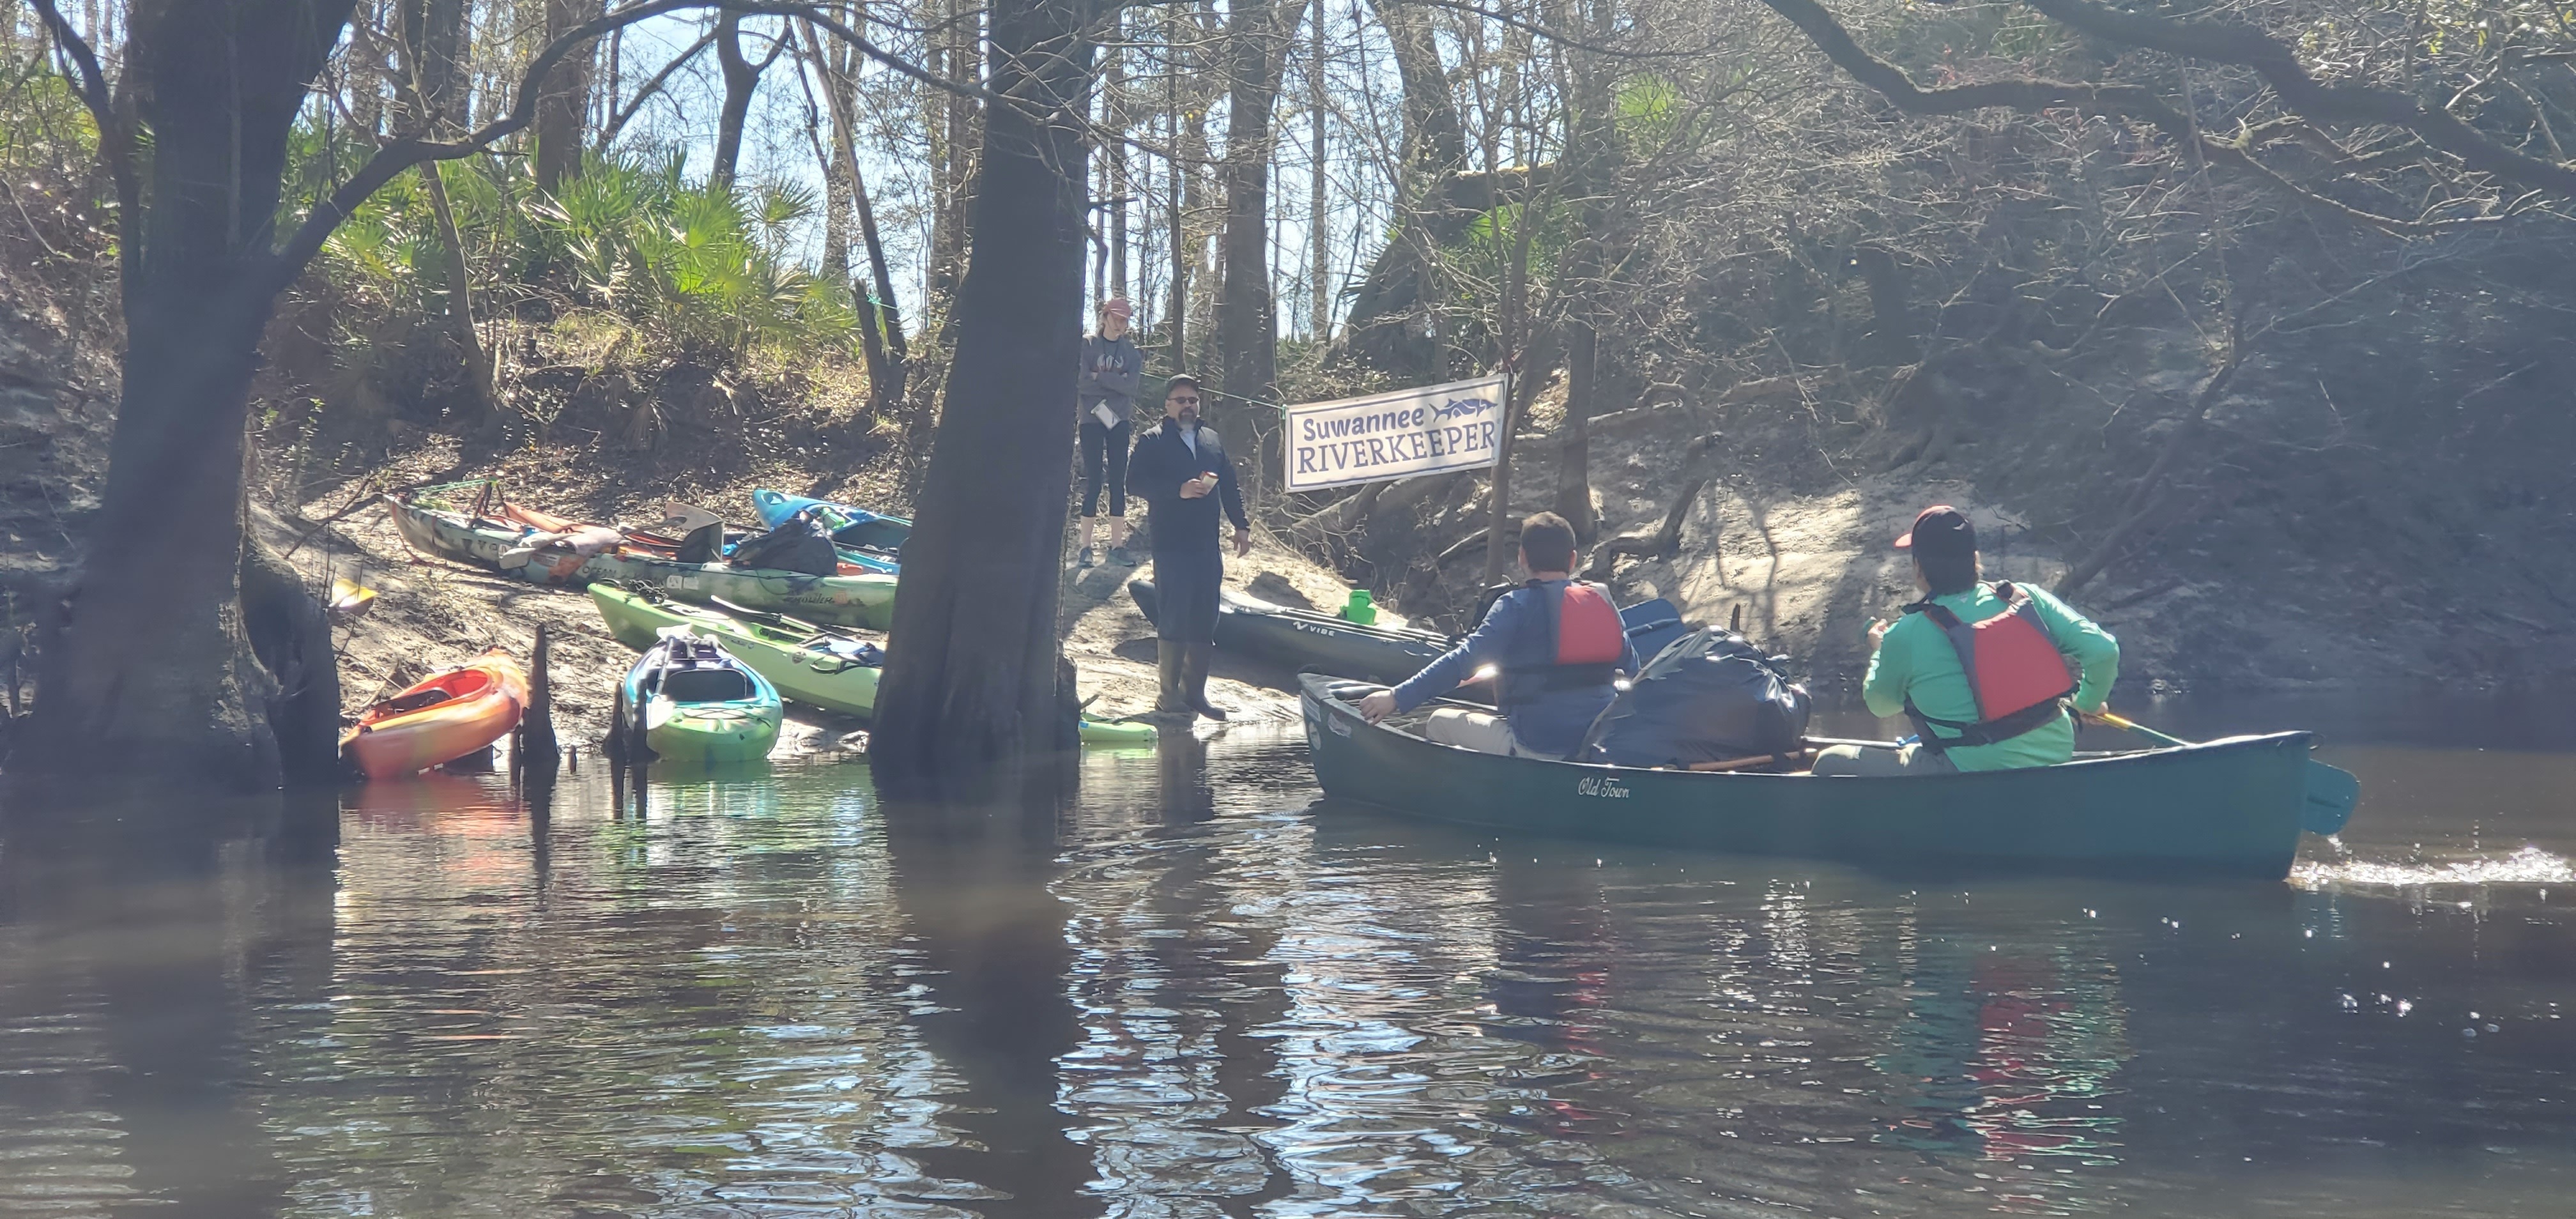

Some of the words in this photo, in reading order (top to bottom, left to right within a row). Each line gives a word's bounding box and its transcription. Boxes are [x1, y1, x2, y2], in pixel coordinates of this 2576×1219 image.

[1303, 408, 1424, 441] Suwannee
[1297, 420, 1495, 474] RIVERKEEPER
[1310, 626, 1335, 636] VIBE
[1578, 777, 1601, 796] Old
[1600, 777, 1630, 798] Town
